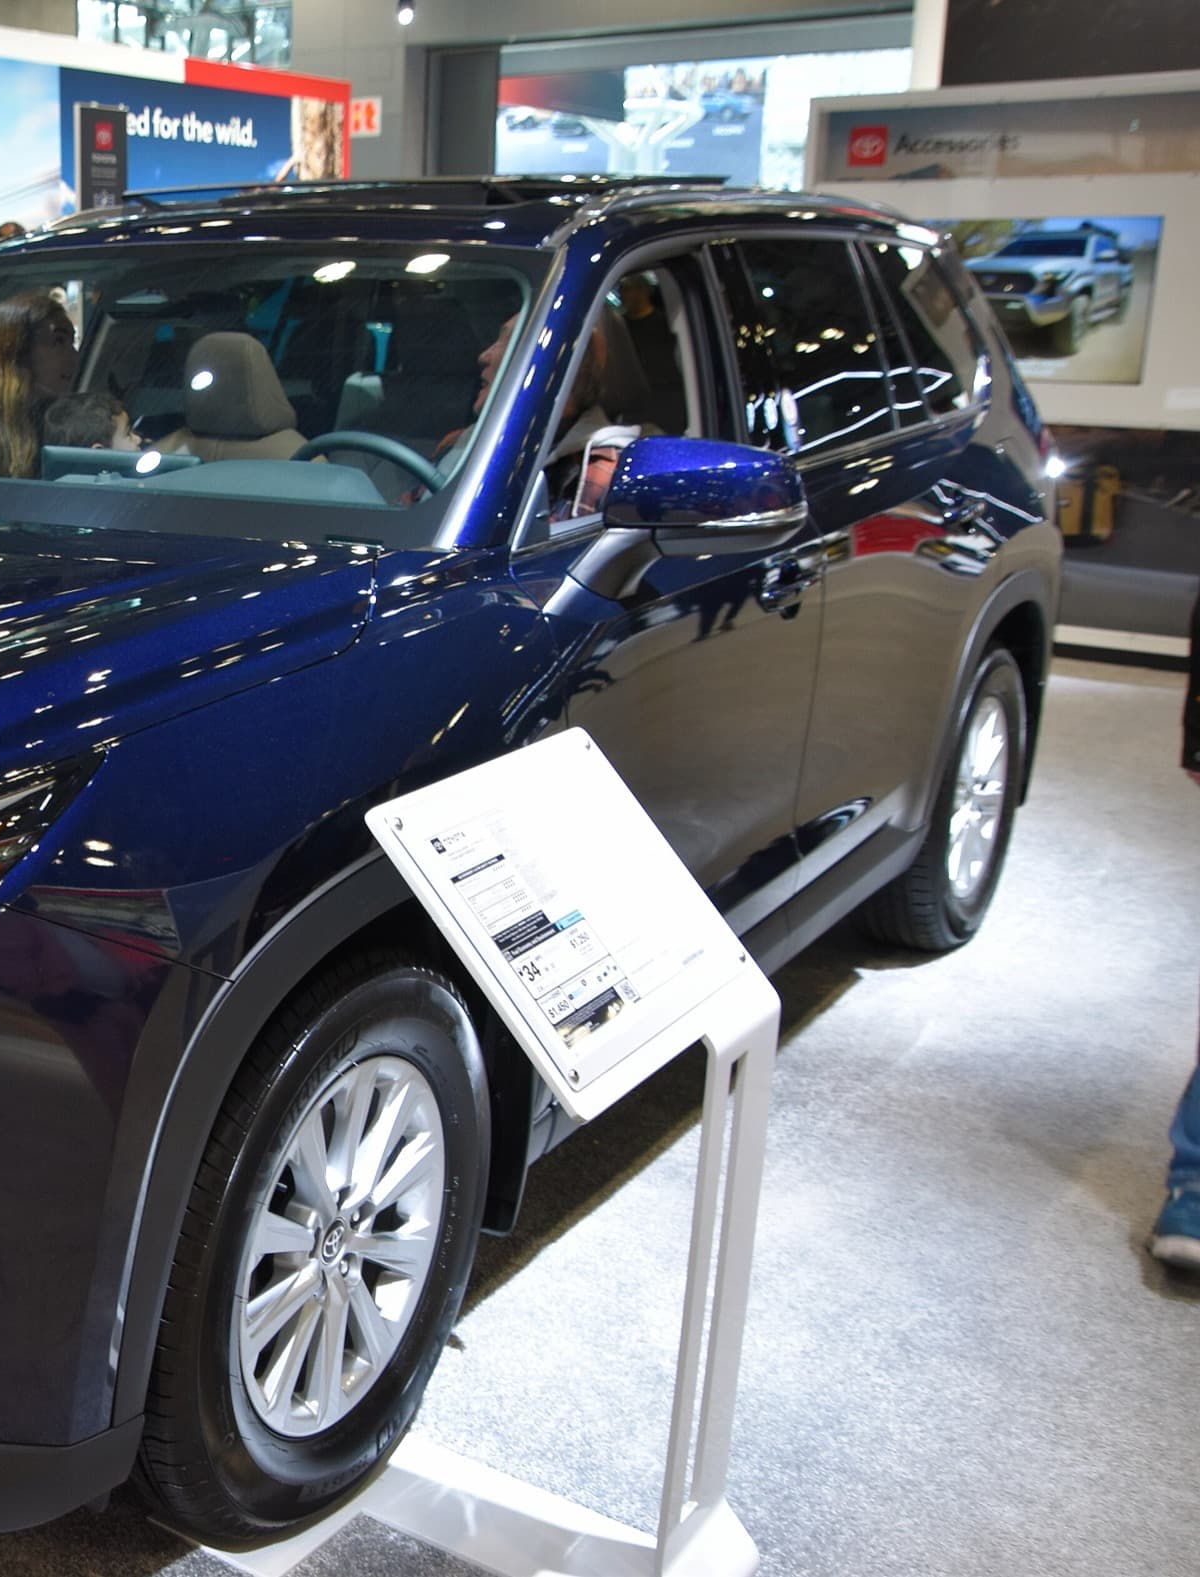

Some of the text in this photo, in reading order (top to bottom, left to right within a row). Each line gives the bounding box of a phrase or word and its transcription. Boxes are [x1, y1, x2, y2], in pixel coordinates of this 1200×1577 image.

[152, 106, 181, 140] for
[182, 111, 214, 143] the
[214, 116, 258, 148] wild.
[522, 960, 542, 982] 34
